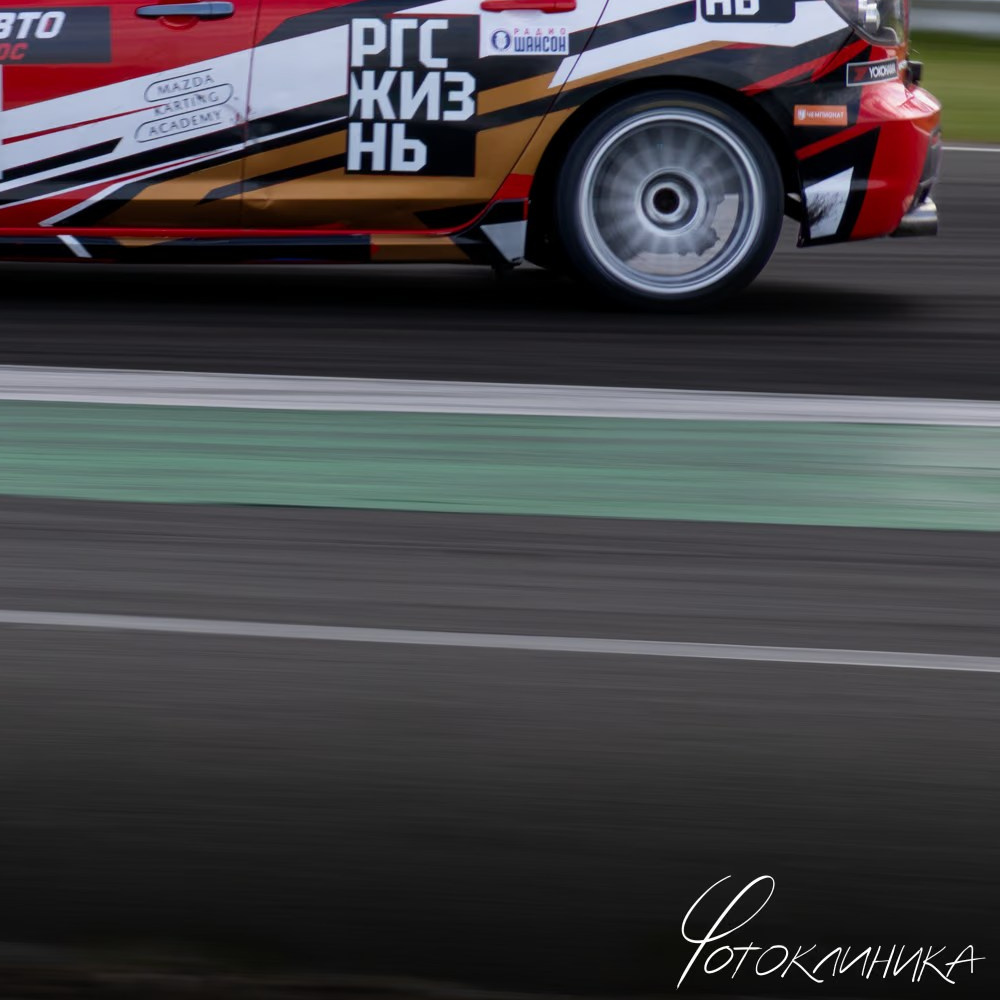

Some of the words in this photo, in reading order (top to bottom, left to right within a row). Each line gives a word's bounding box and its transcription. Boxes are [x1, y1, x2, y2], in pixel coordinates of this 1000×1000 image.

[351, 17, 449, 69] РГС
[513, 27, 567, 36] РАДИО
[514, 36, 566, 52] ШАНСОН
[156, 74, 215, 95] MAZDA
[349, 69, 477, 122] ЖИЗ
[154, 91, 219, 116] KARTING
[148, 109, 222, 137] ACADEMY
[346, 122, 428, 172] НЬ
